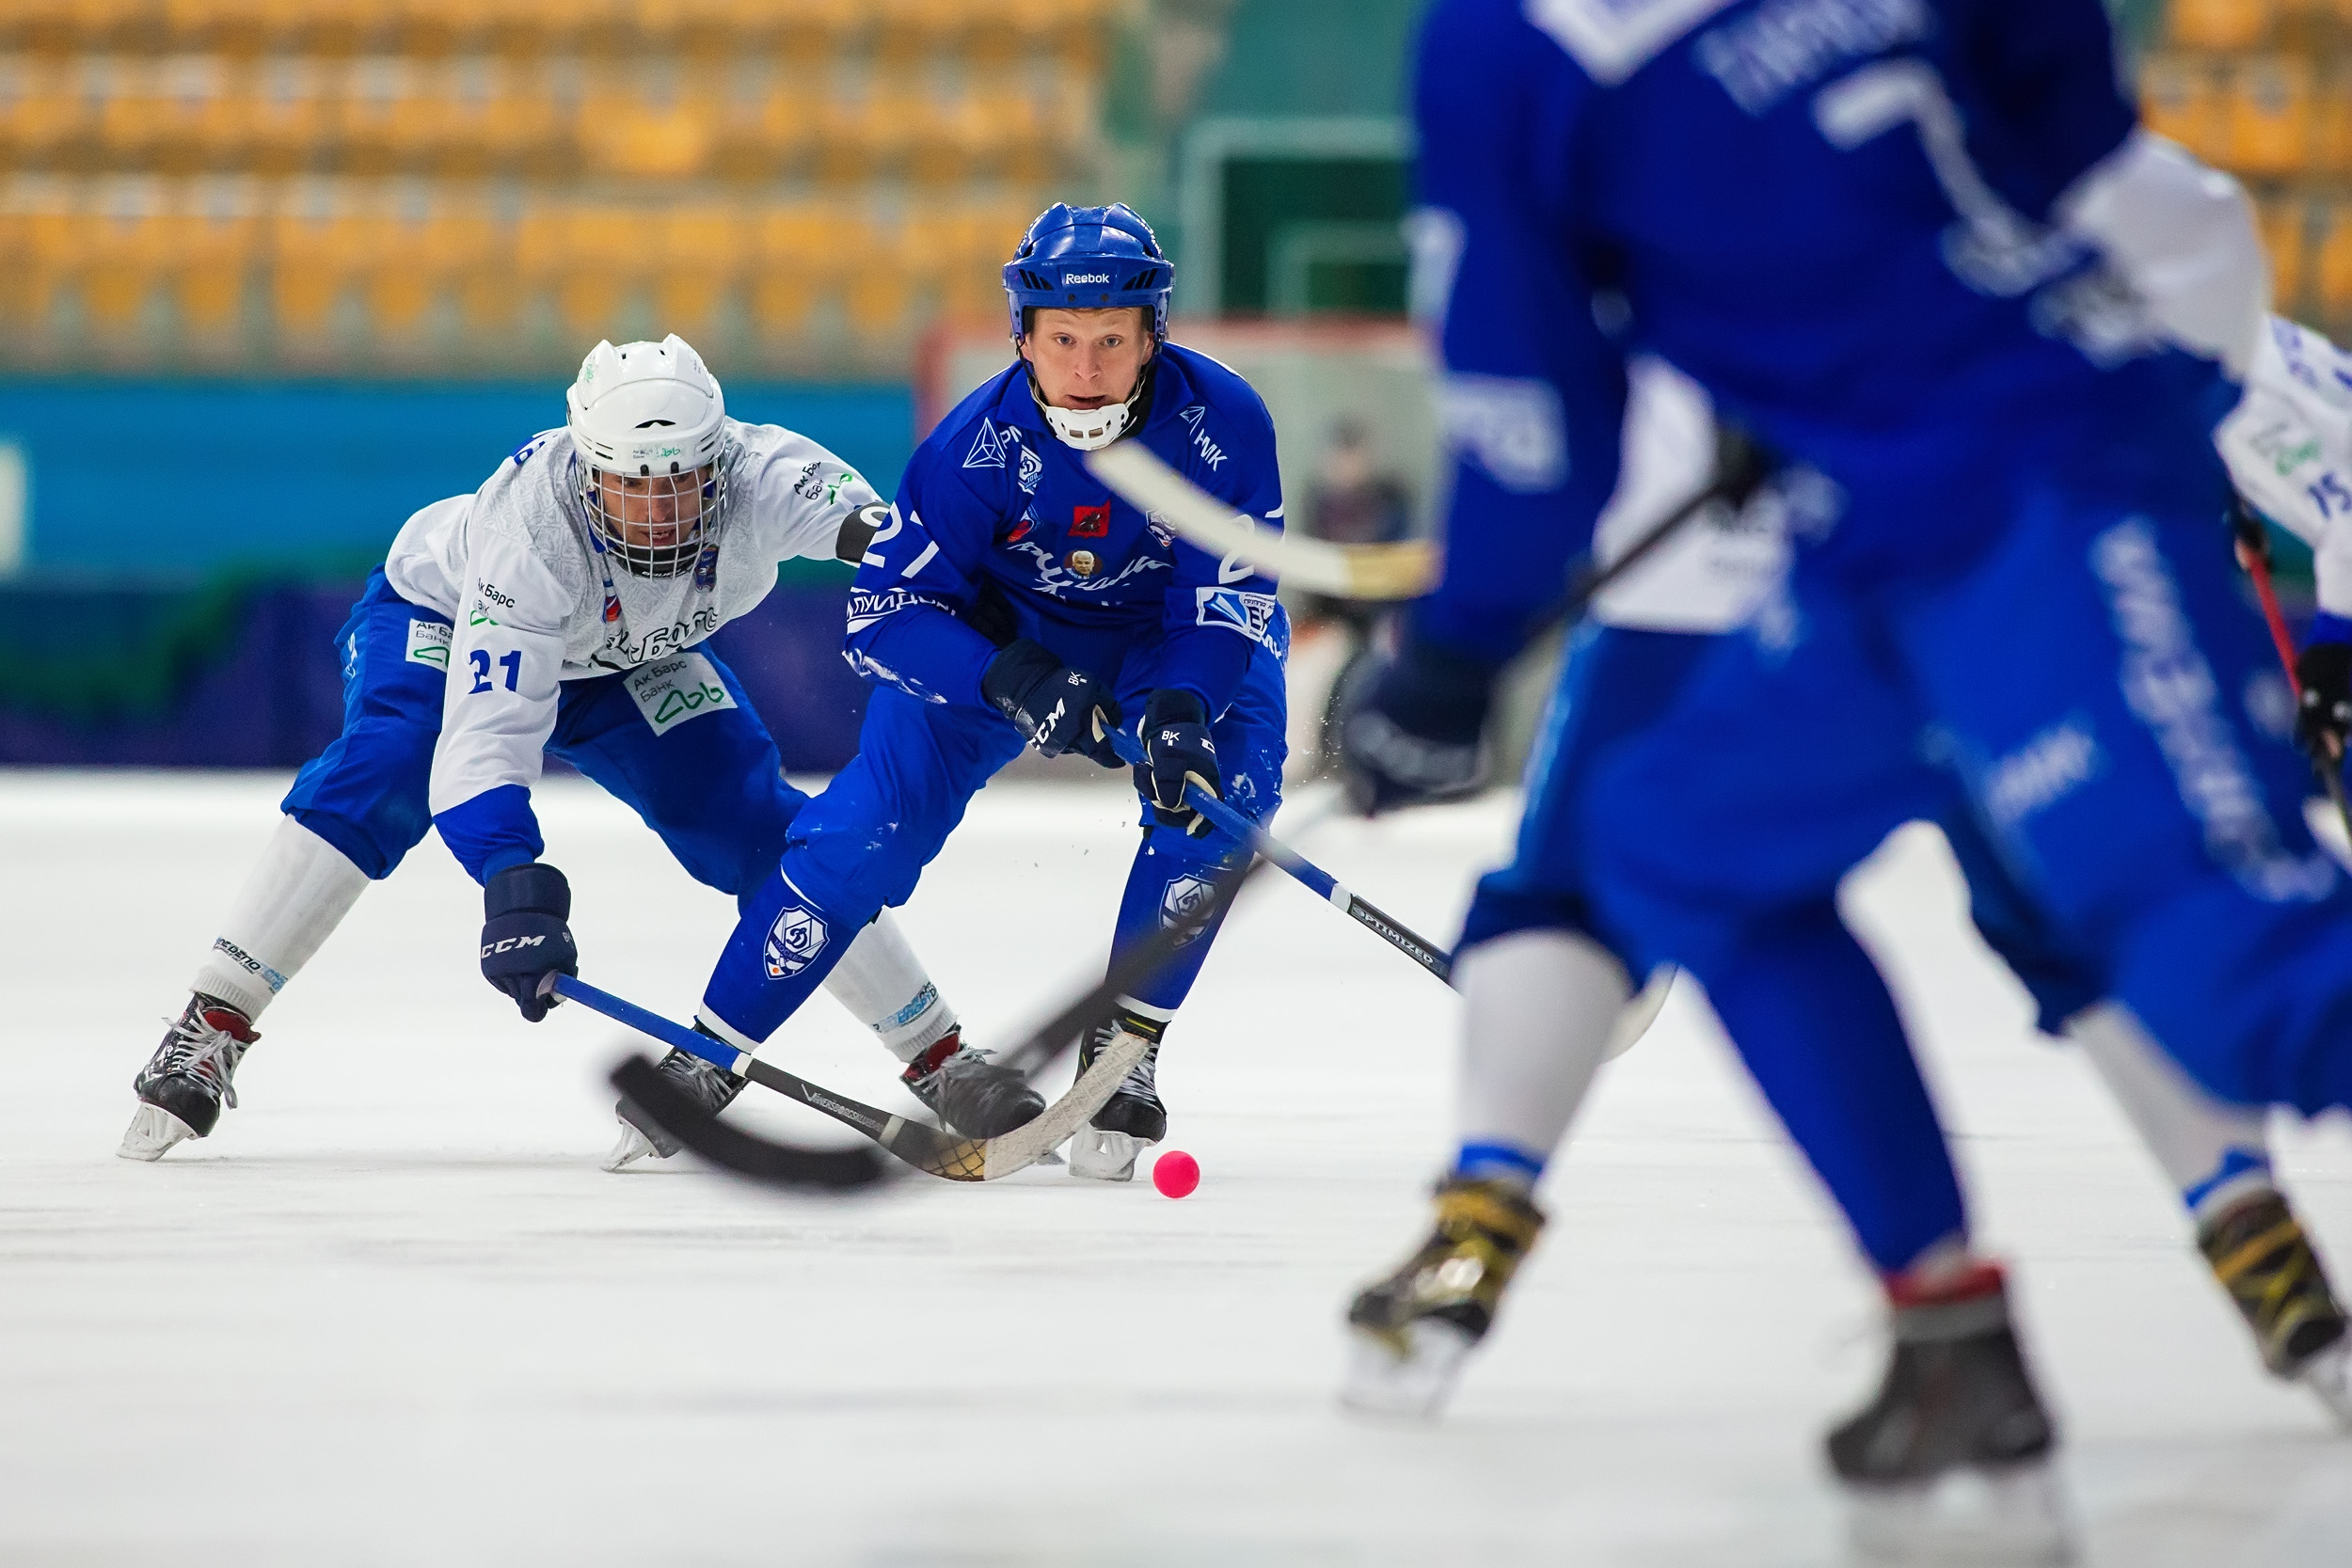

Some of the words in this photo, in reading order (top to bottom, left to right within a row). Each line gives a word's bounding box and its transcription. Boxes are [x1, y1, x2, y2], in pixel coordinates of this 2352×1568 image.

[1066, 273, 1110, 285] Reebok
[793, 475, 809, 495] Ак
[861, 499, 940, 579] 27
[485, 583, 516, 609] Барс
[415, 630, 452, 647] Банк
[417, 622, 437, 631] Ак
[468, 649, 522, 695] 21
[633, 674, 653, 691] Ак
[651, 659, 688, 677] Барс
[639, 678, 676, 704] Банк
[1027, 697, 1066, 752] CCM
[1352, 903, 1434, 964] OPTIMIZED
[481, 935, 546, 959] CCM
[773, 939, 803, 963] МОСКВА
